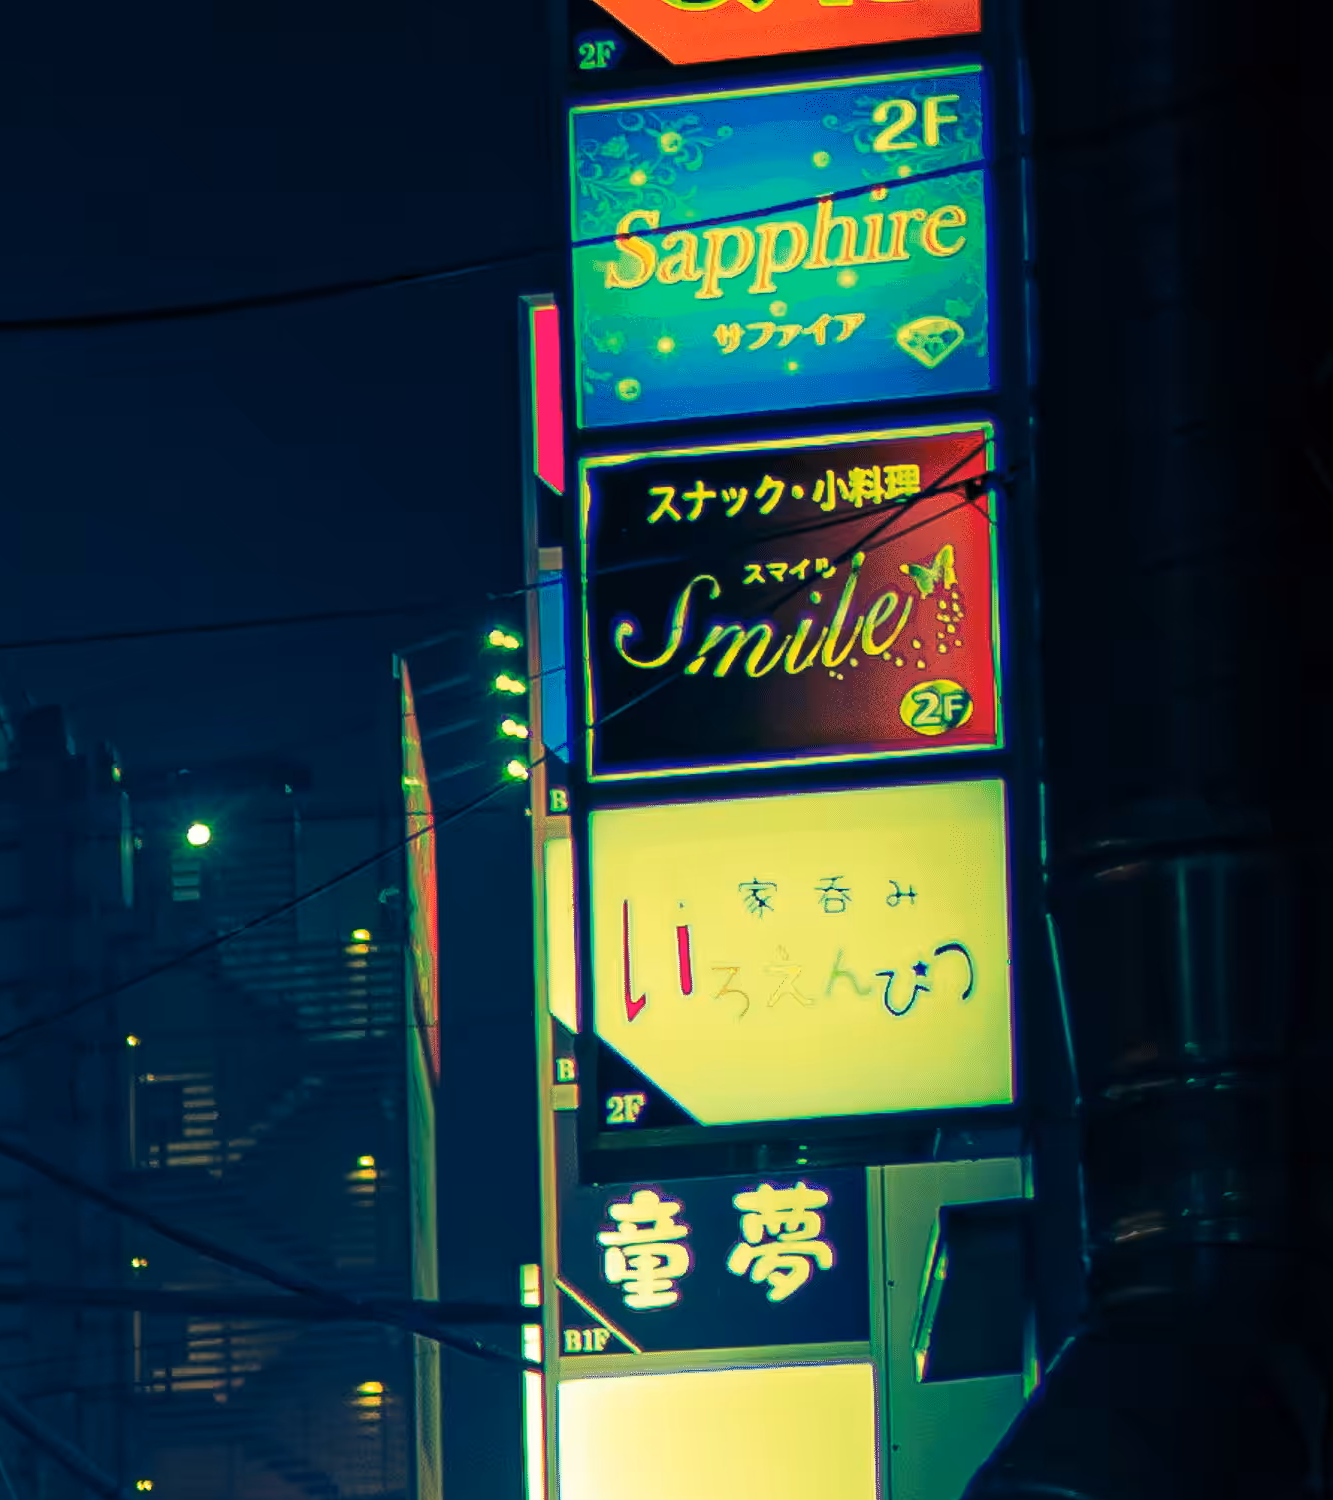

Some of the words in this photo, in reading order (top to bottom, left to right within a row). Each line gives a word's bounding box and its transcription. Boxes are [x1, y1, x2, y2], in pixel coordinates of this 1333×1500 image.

[578, 41, 616, 70] 2F
[872, 95, 960, 154] 2F
[604, 185, 968, 299] Sapphire
[714, 312, 866, 353] サファイア
[647, 464, 922, 524] スナック・小料理
[614, 554, 913, 679] Smile
[910, 688, 965, 729] 2F
[606, 1094, 646, 1124] 2F
[565, 1327, 612, 1353] B1F
